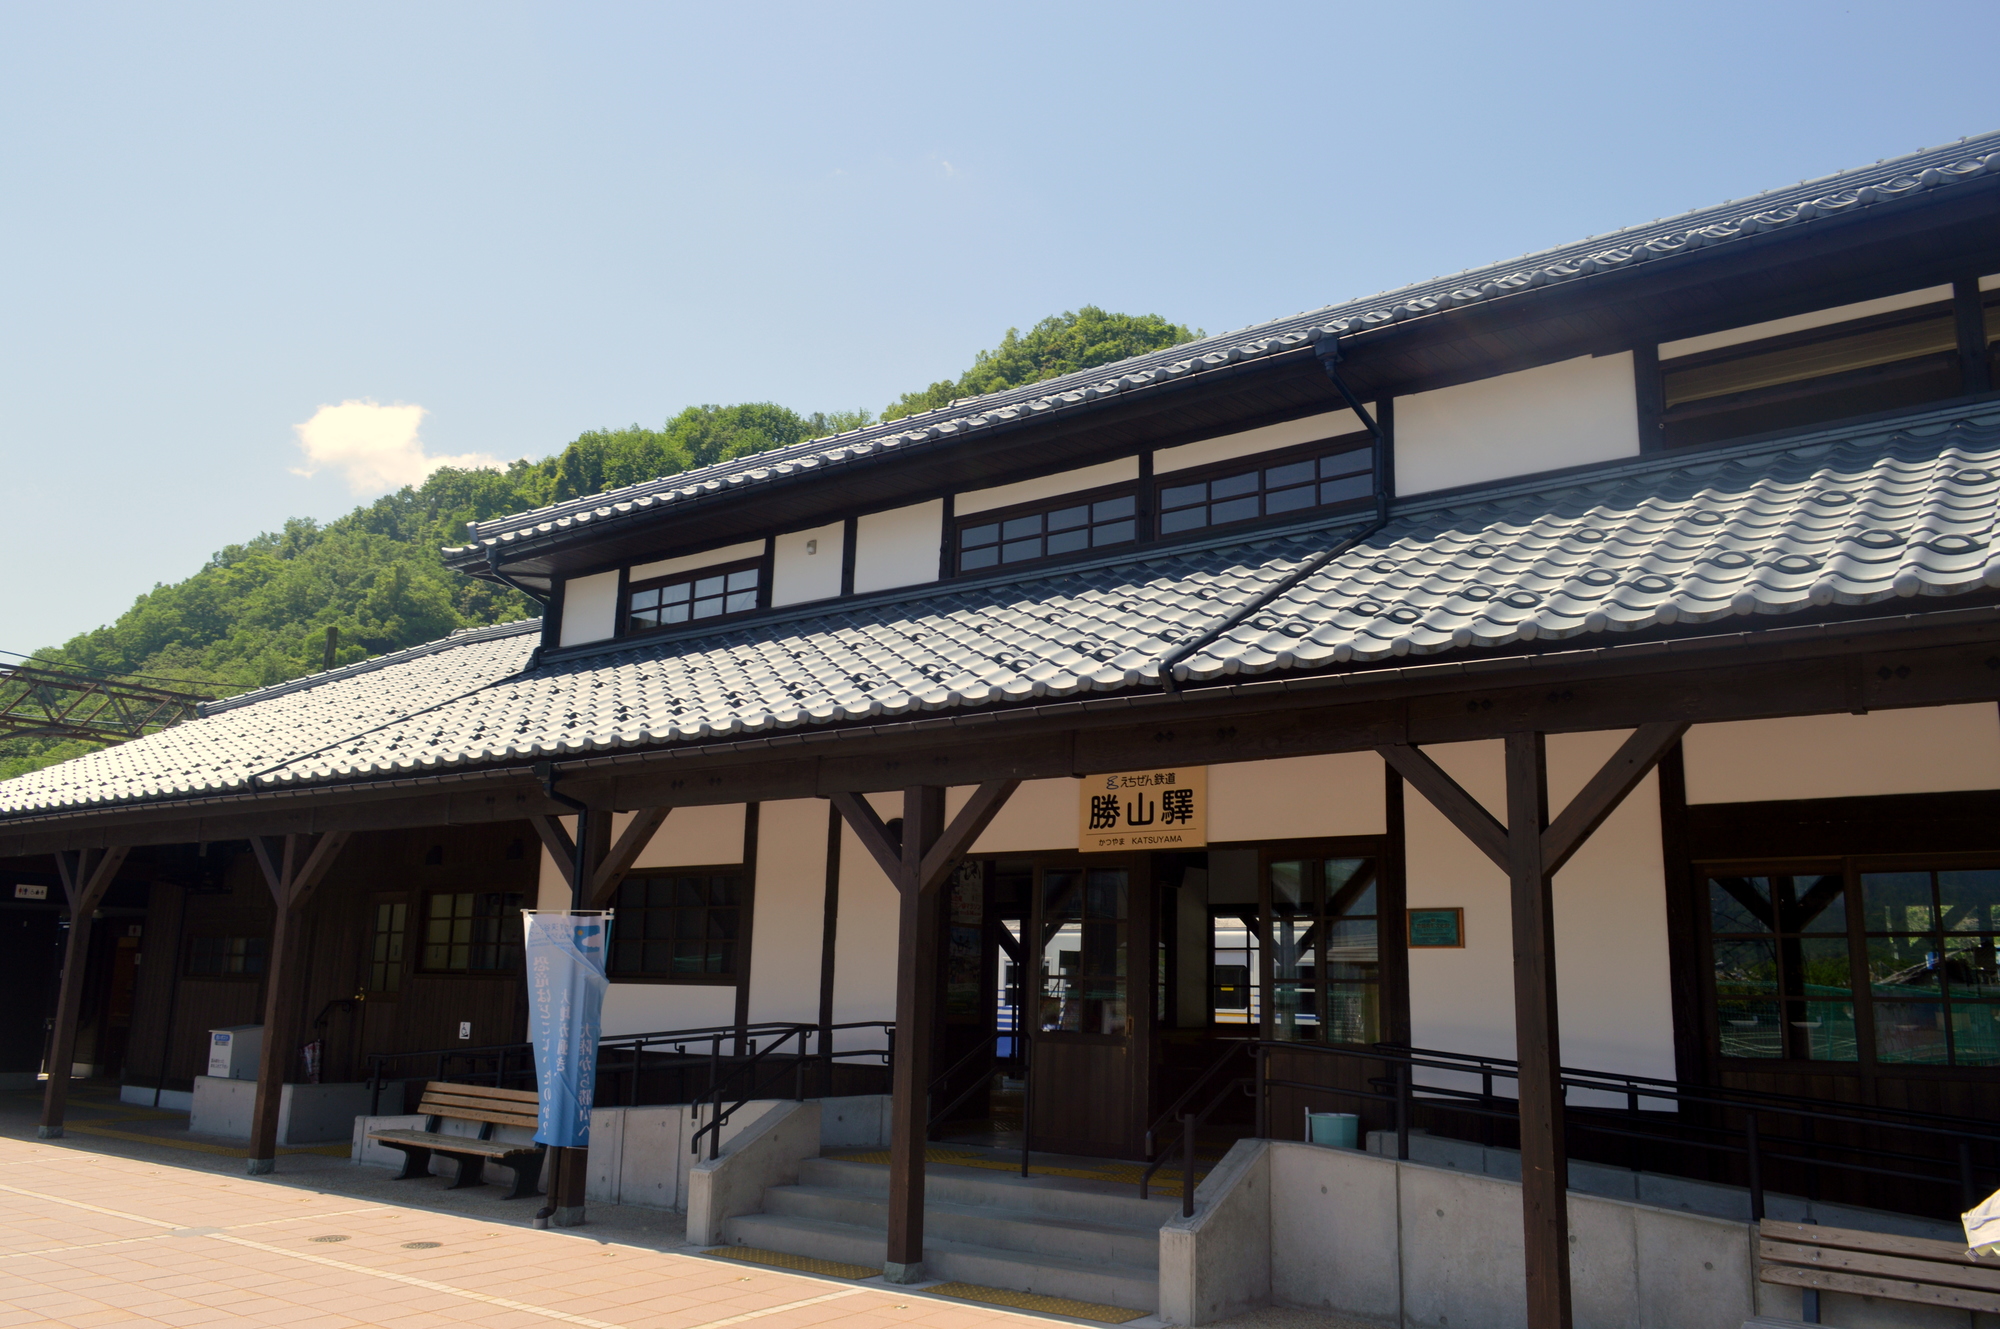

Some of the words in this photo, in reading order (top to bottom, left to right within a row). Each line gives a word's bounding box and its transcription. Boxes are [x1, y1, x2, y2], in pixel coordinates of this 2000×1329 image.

[1120, 773, 1176, 788] えちぜん鉄道
[1088, 788, 1194, 830] 勝山驛
[1098, 838, 1125, 846] かつやま
[1131, 835, 1182, 845] KATSUYAMA
